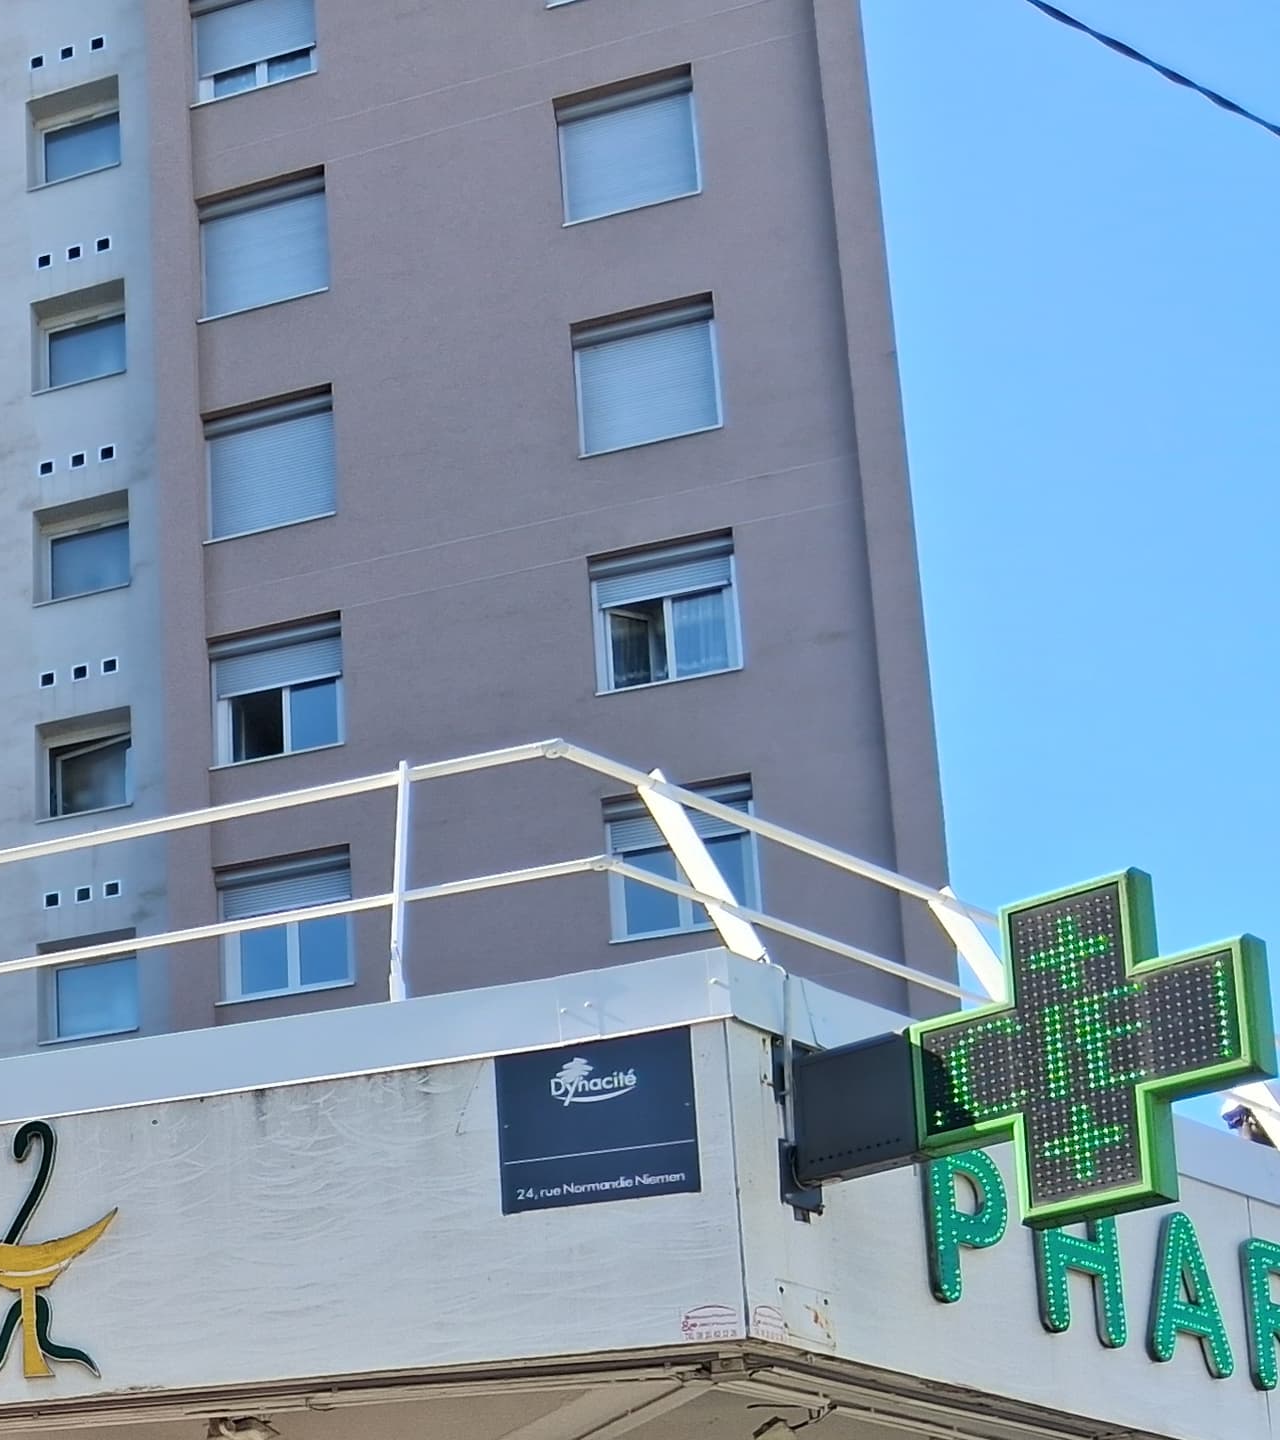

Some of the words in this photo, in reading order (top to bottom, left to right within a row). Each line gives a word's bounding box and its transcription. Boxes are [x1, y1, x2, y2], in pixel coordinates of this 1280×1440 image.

[934, 983, 1146, 1126] CIE
[551, 1067, 637, 1106] Dynacité
[540, 1187, 562, 1198] rue
[563, 1177, 634, 1195] Normandie
[635, 1172, 686, 1186] Niemen
